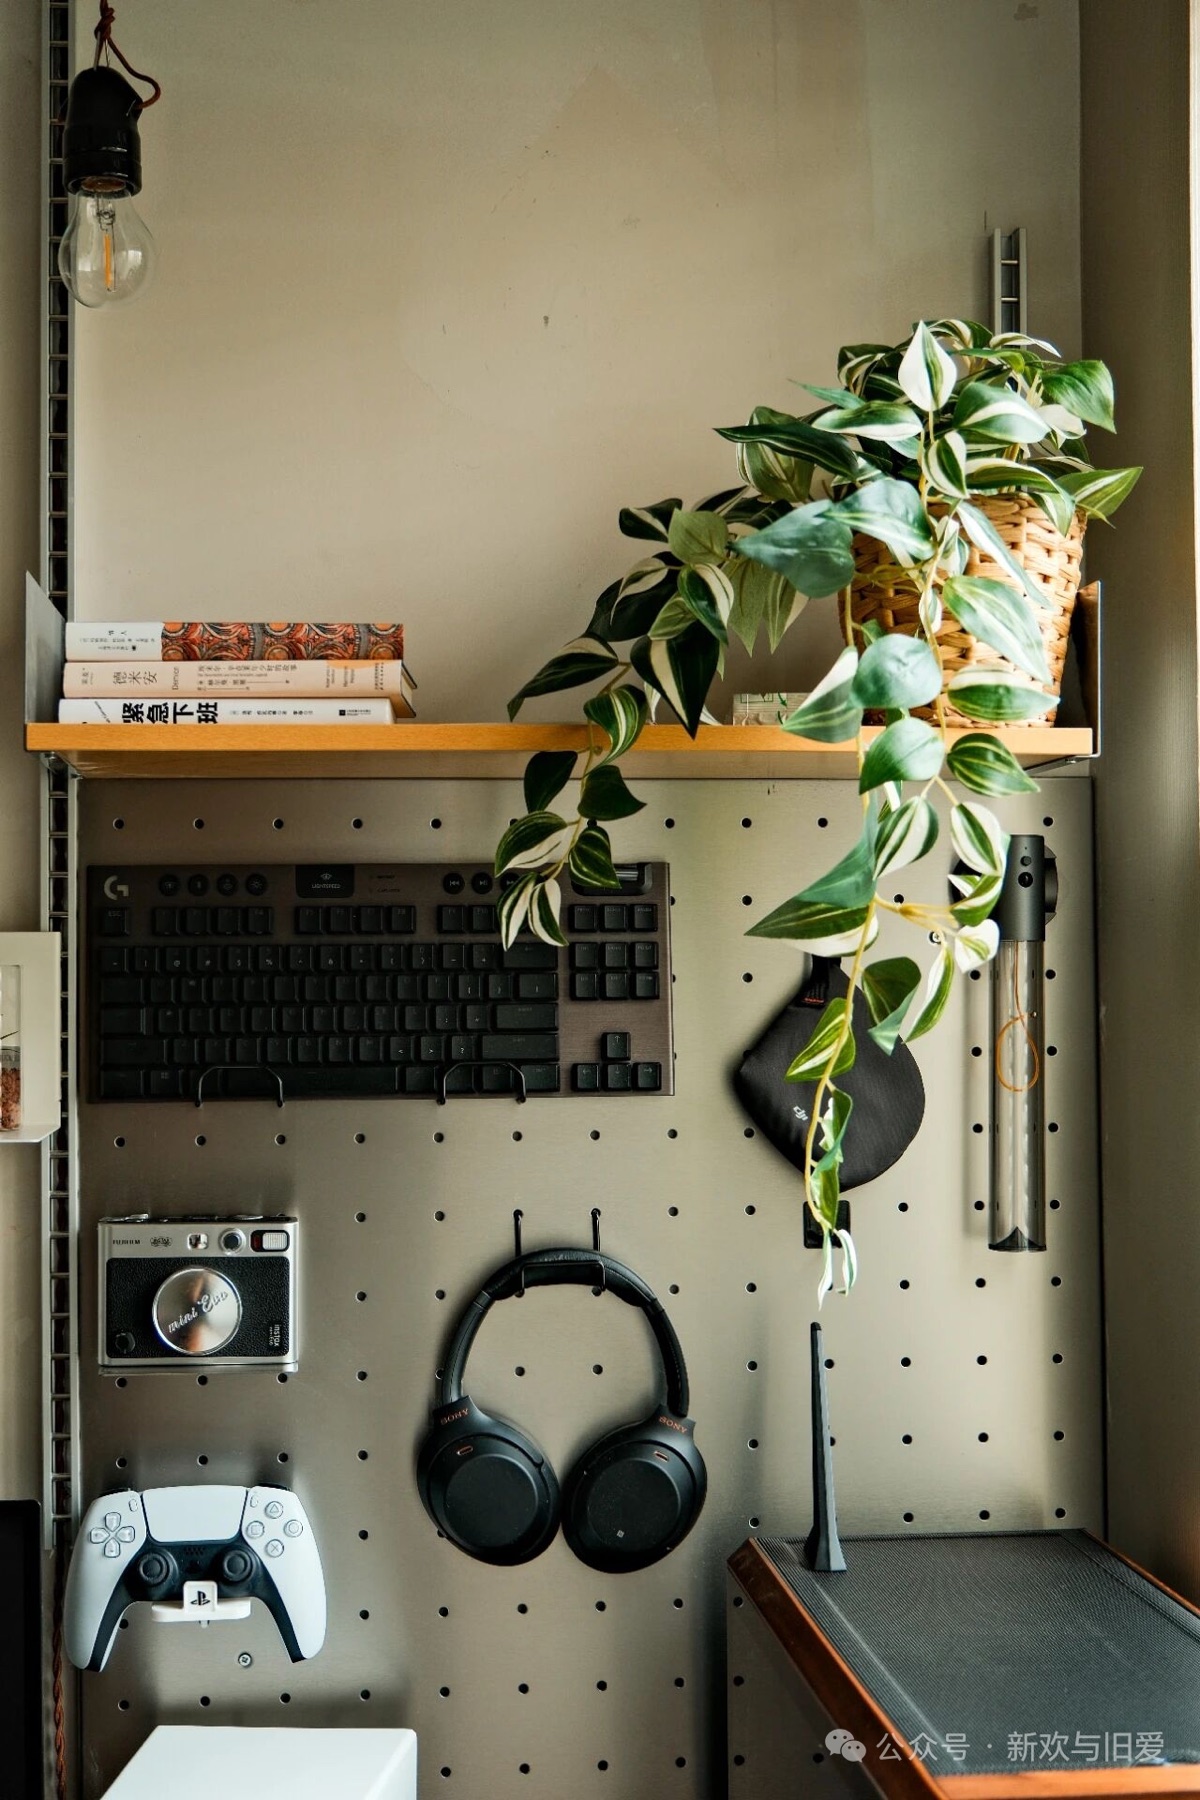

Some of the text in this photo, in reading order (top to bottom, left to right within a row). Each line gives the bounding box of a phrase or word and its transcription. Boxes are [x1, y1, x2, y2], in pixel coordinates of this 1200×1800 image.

[113, 671, 157, 685] 德米安
[122, 702, 218, 724] 紧急下班
[168, 1307, 198, 1333] mini
[273, 1324, 282, 1347] instax
[440, 1407, 470, 1425] SONY
[658, 1416, 688, 1433] SONY
